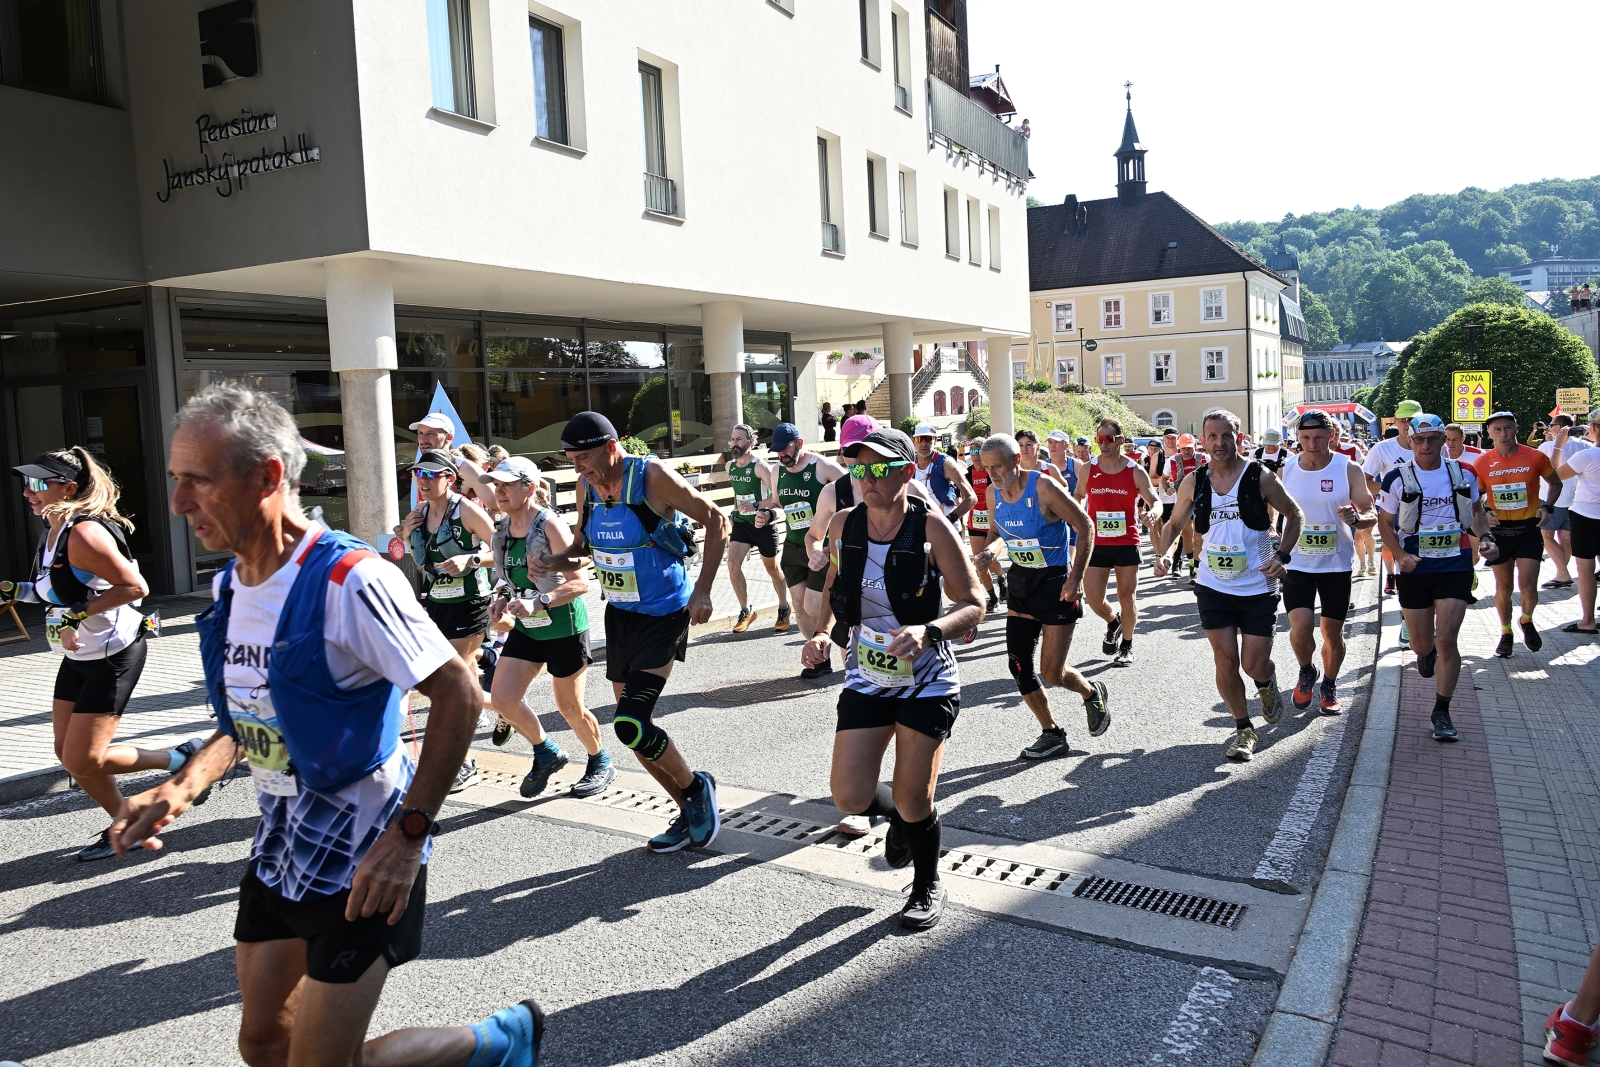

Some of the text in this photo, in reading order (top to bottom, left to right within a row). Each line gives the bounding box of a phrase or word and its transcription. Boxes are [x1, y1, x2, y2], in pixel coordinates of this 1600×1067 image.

[196, 109, 272, 153] Pension
[1459, 372, 1484, 382] ZÓNA
[1488, 466, 1531, 477] ESPAÑA
[1499, 492, 1519, 501] 481
[791, 510, 806, 520] 110
[1102, 521, 1120, 529] 263
[597, 531, 625, 540] ITALIA
[1306, 534, 1328, 545] 518
[1429, 535, 1452, 546] 378
[1014, 551, 1035, 562] 150
[1217, 556, 1234, 567] 22
[600, 570, 625, 588] 795
[866, 649, 898, 671] 622
